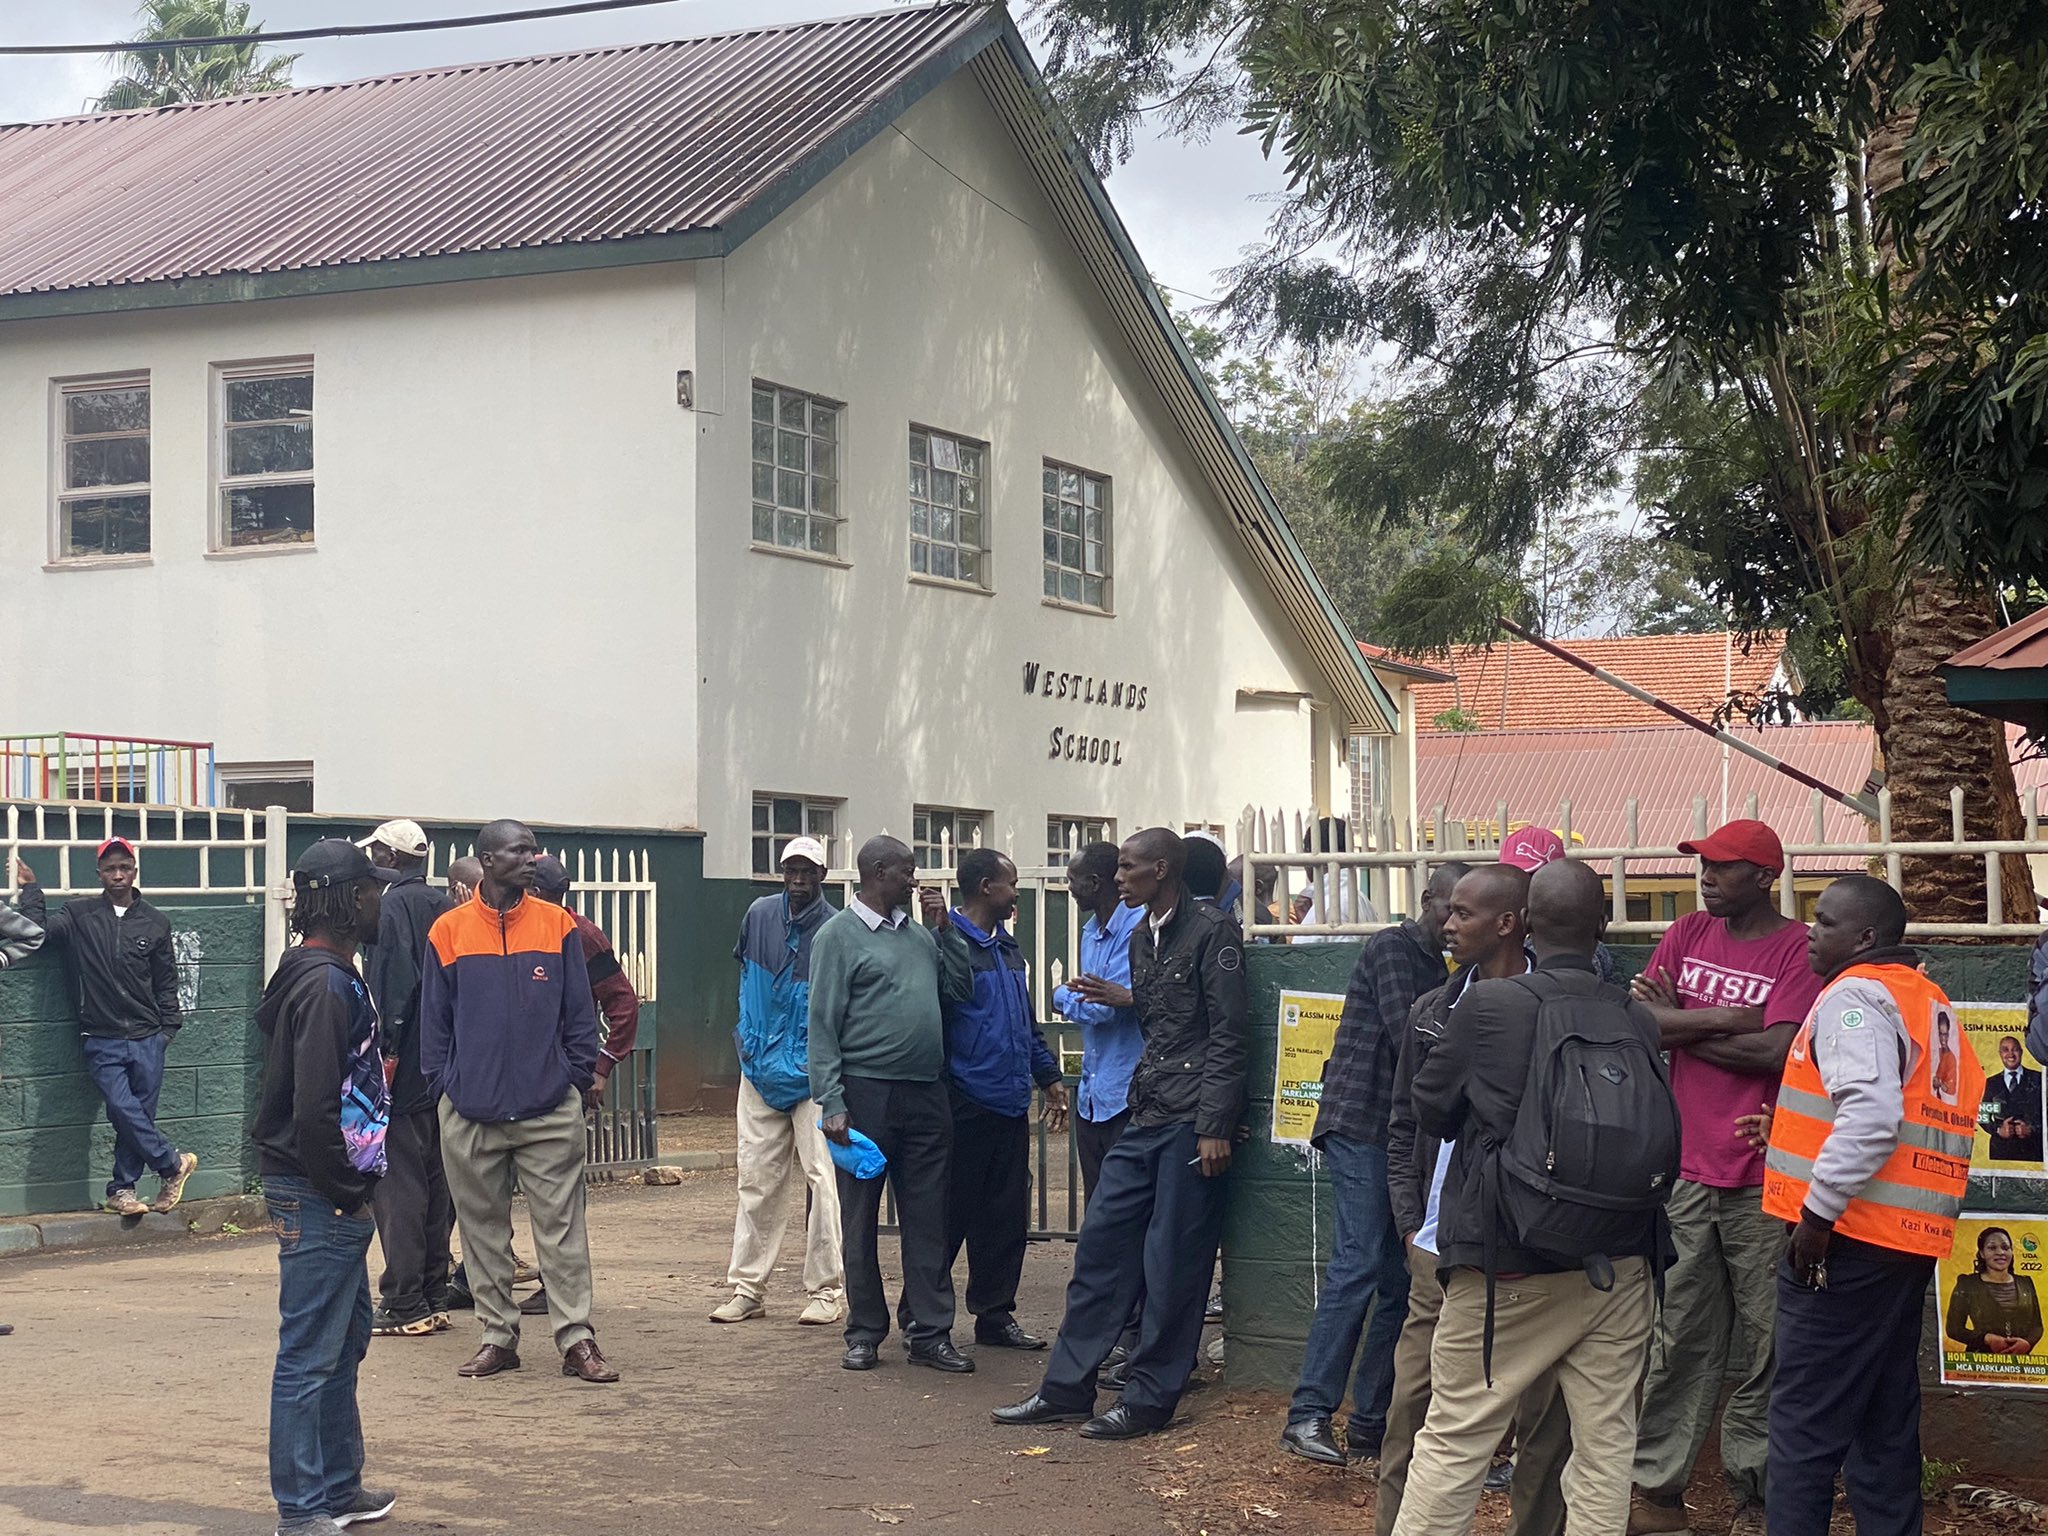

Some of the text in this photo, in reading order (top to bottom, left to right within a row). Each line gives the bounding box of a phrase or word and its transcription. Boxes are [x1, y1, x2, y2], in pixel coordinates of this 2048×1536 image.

[1023, 661, 1147, 711] WESTLANDS
[1049, 726, 1122, 766] SCHOOL
[1677, 964, 1770, 1006] MTSU
[1300, 1011, 1323, 1019] KASSIM
[1963, 1024, 1984, 1032] SSIM
[1280, 1098, 1315, 1108] FOR REAL
[1979, 1104, 1999, 1112] NGE
[1901, 1218, 1921, 1231] Kazi
[2021, 1262, 2043, 1271] 2022
[1947, 1352, 1969, 1362] HON.
[1972, 1353, 2013, 1364] VIRGINIA
[1956, 1363, 2046, 1375] MCA PARKLANDS WARD
